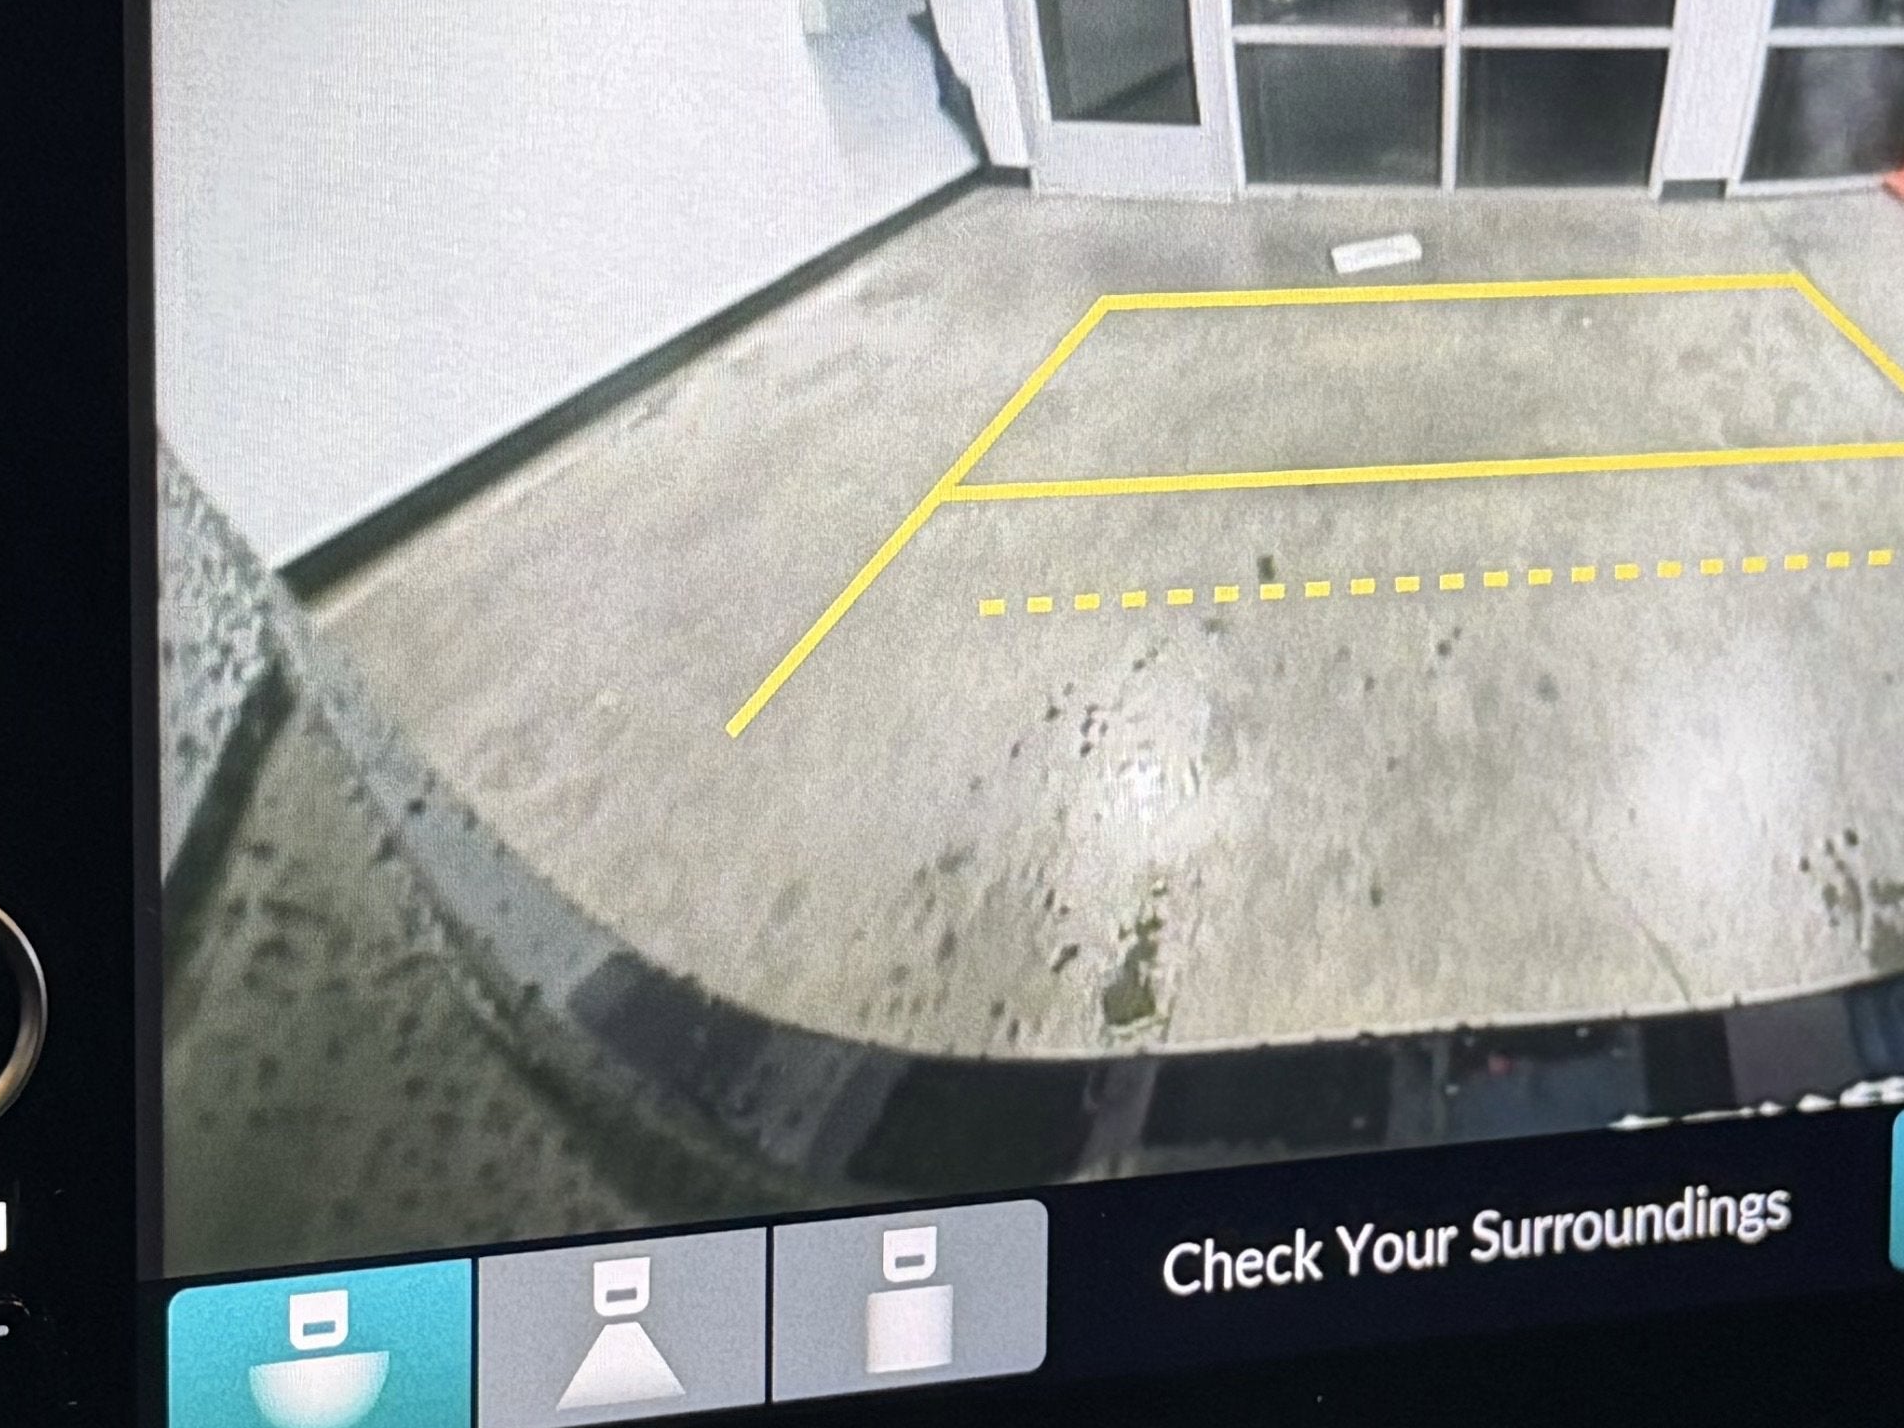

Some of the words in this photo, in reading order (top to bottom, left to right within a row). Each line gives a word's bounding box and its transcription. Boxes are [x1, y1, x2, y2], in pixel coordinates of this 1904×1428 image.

[1163, 1227, 1323, 1295] Check
[1335, 1223, 1459, 1276] Your
[1470, 1184, 1791, 1262] Surroundings
